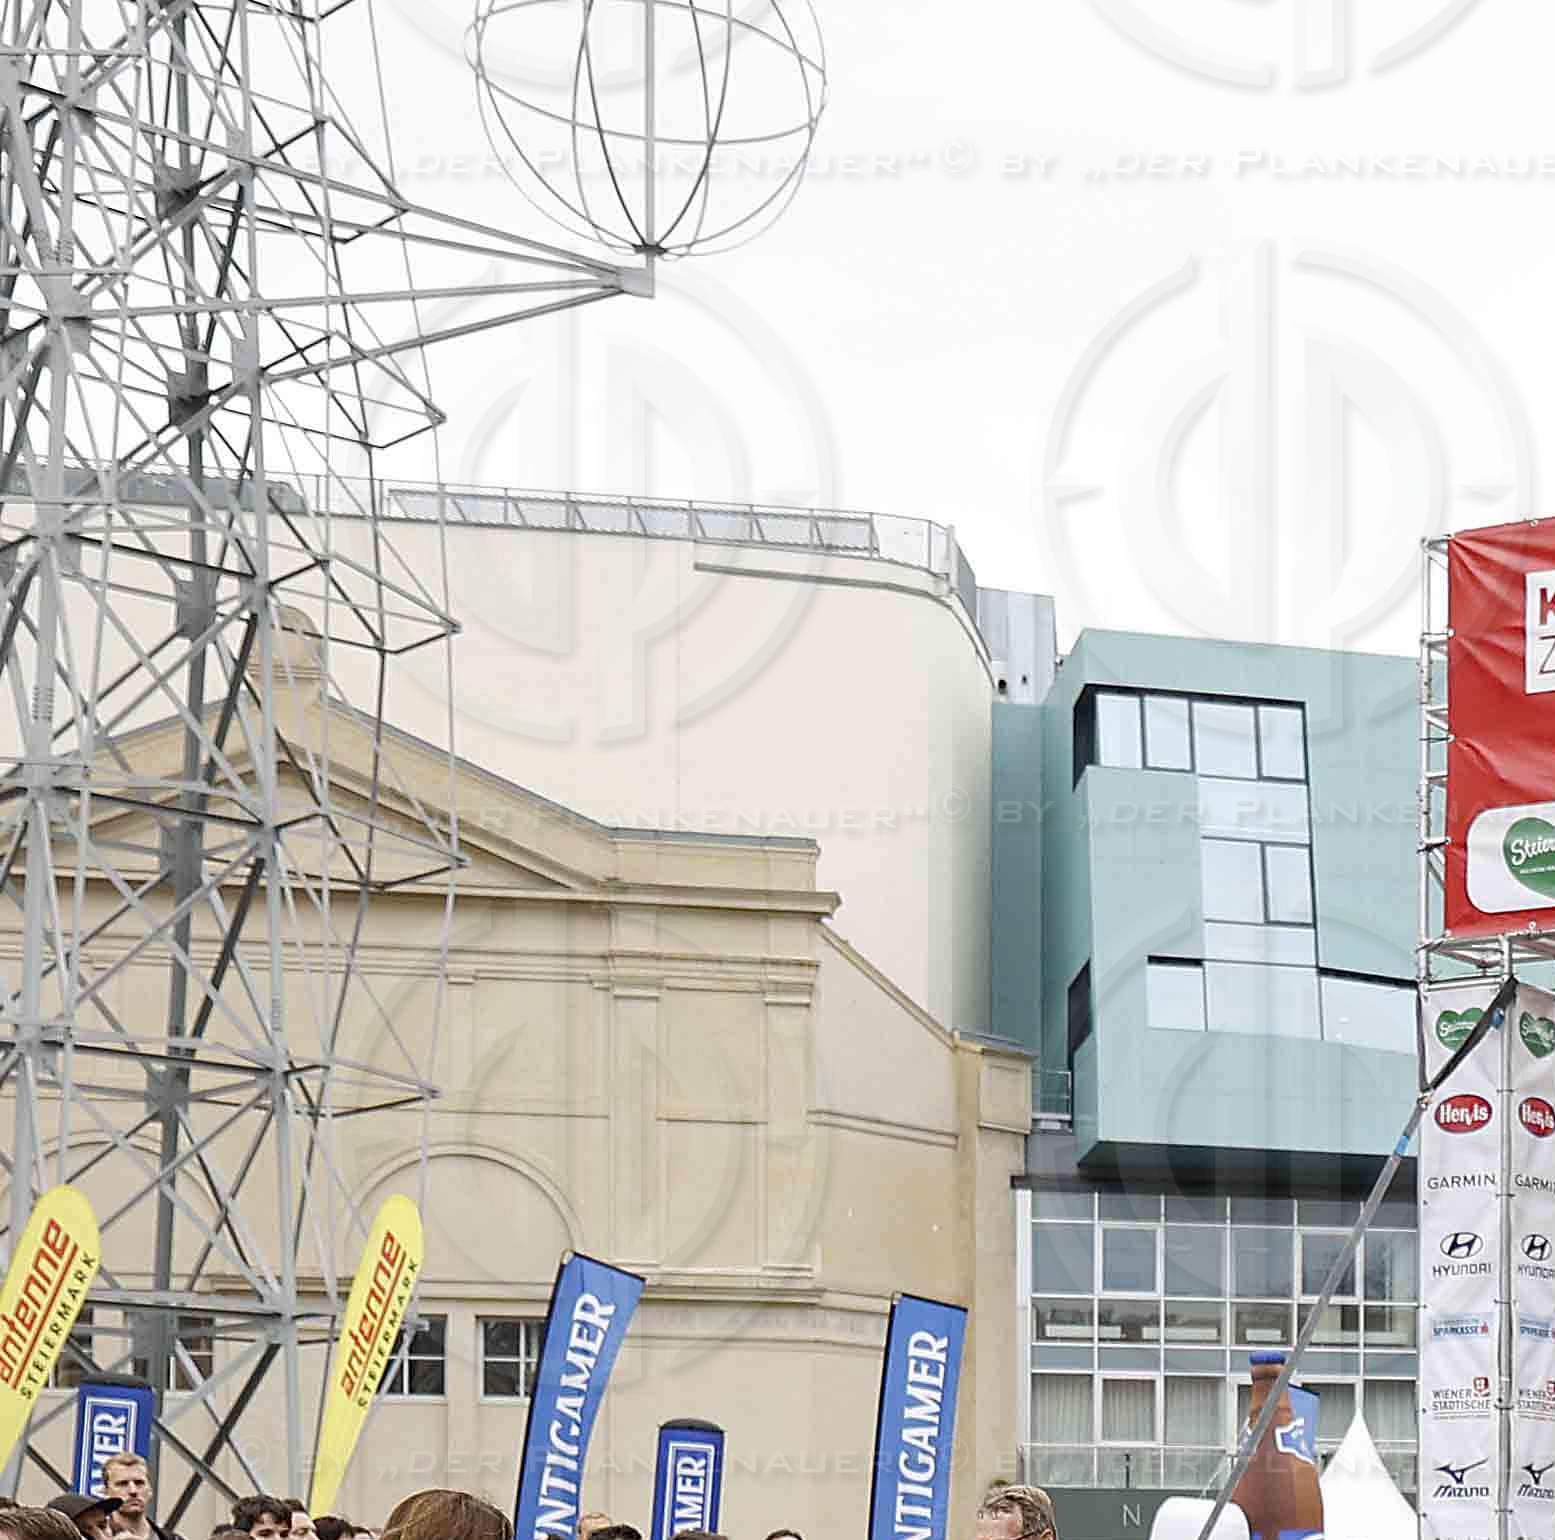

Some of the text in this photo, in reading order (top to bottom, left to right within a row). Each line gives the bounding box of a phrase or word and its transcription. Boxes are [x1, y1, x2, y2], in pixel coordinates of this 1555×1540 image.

[1427, 1175, 1497, 1190] GARMIN
[1439, 1100, 1488, 1126] Hervis
[0, 1218, 69, 1385] antenne
[20, 1251, 96, 1401] STEIERMARK
[339, 1231, 405, 1399] antenne
[357, 1257, 420, 1408] STEIERMARK
[1432, 1263, 1492, 1277] HYUNDAI
[535, 1293, 616, 1536] NTIGAMER
[1432, 1389, 1471, 1401] WIENER
